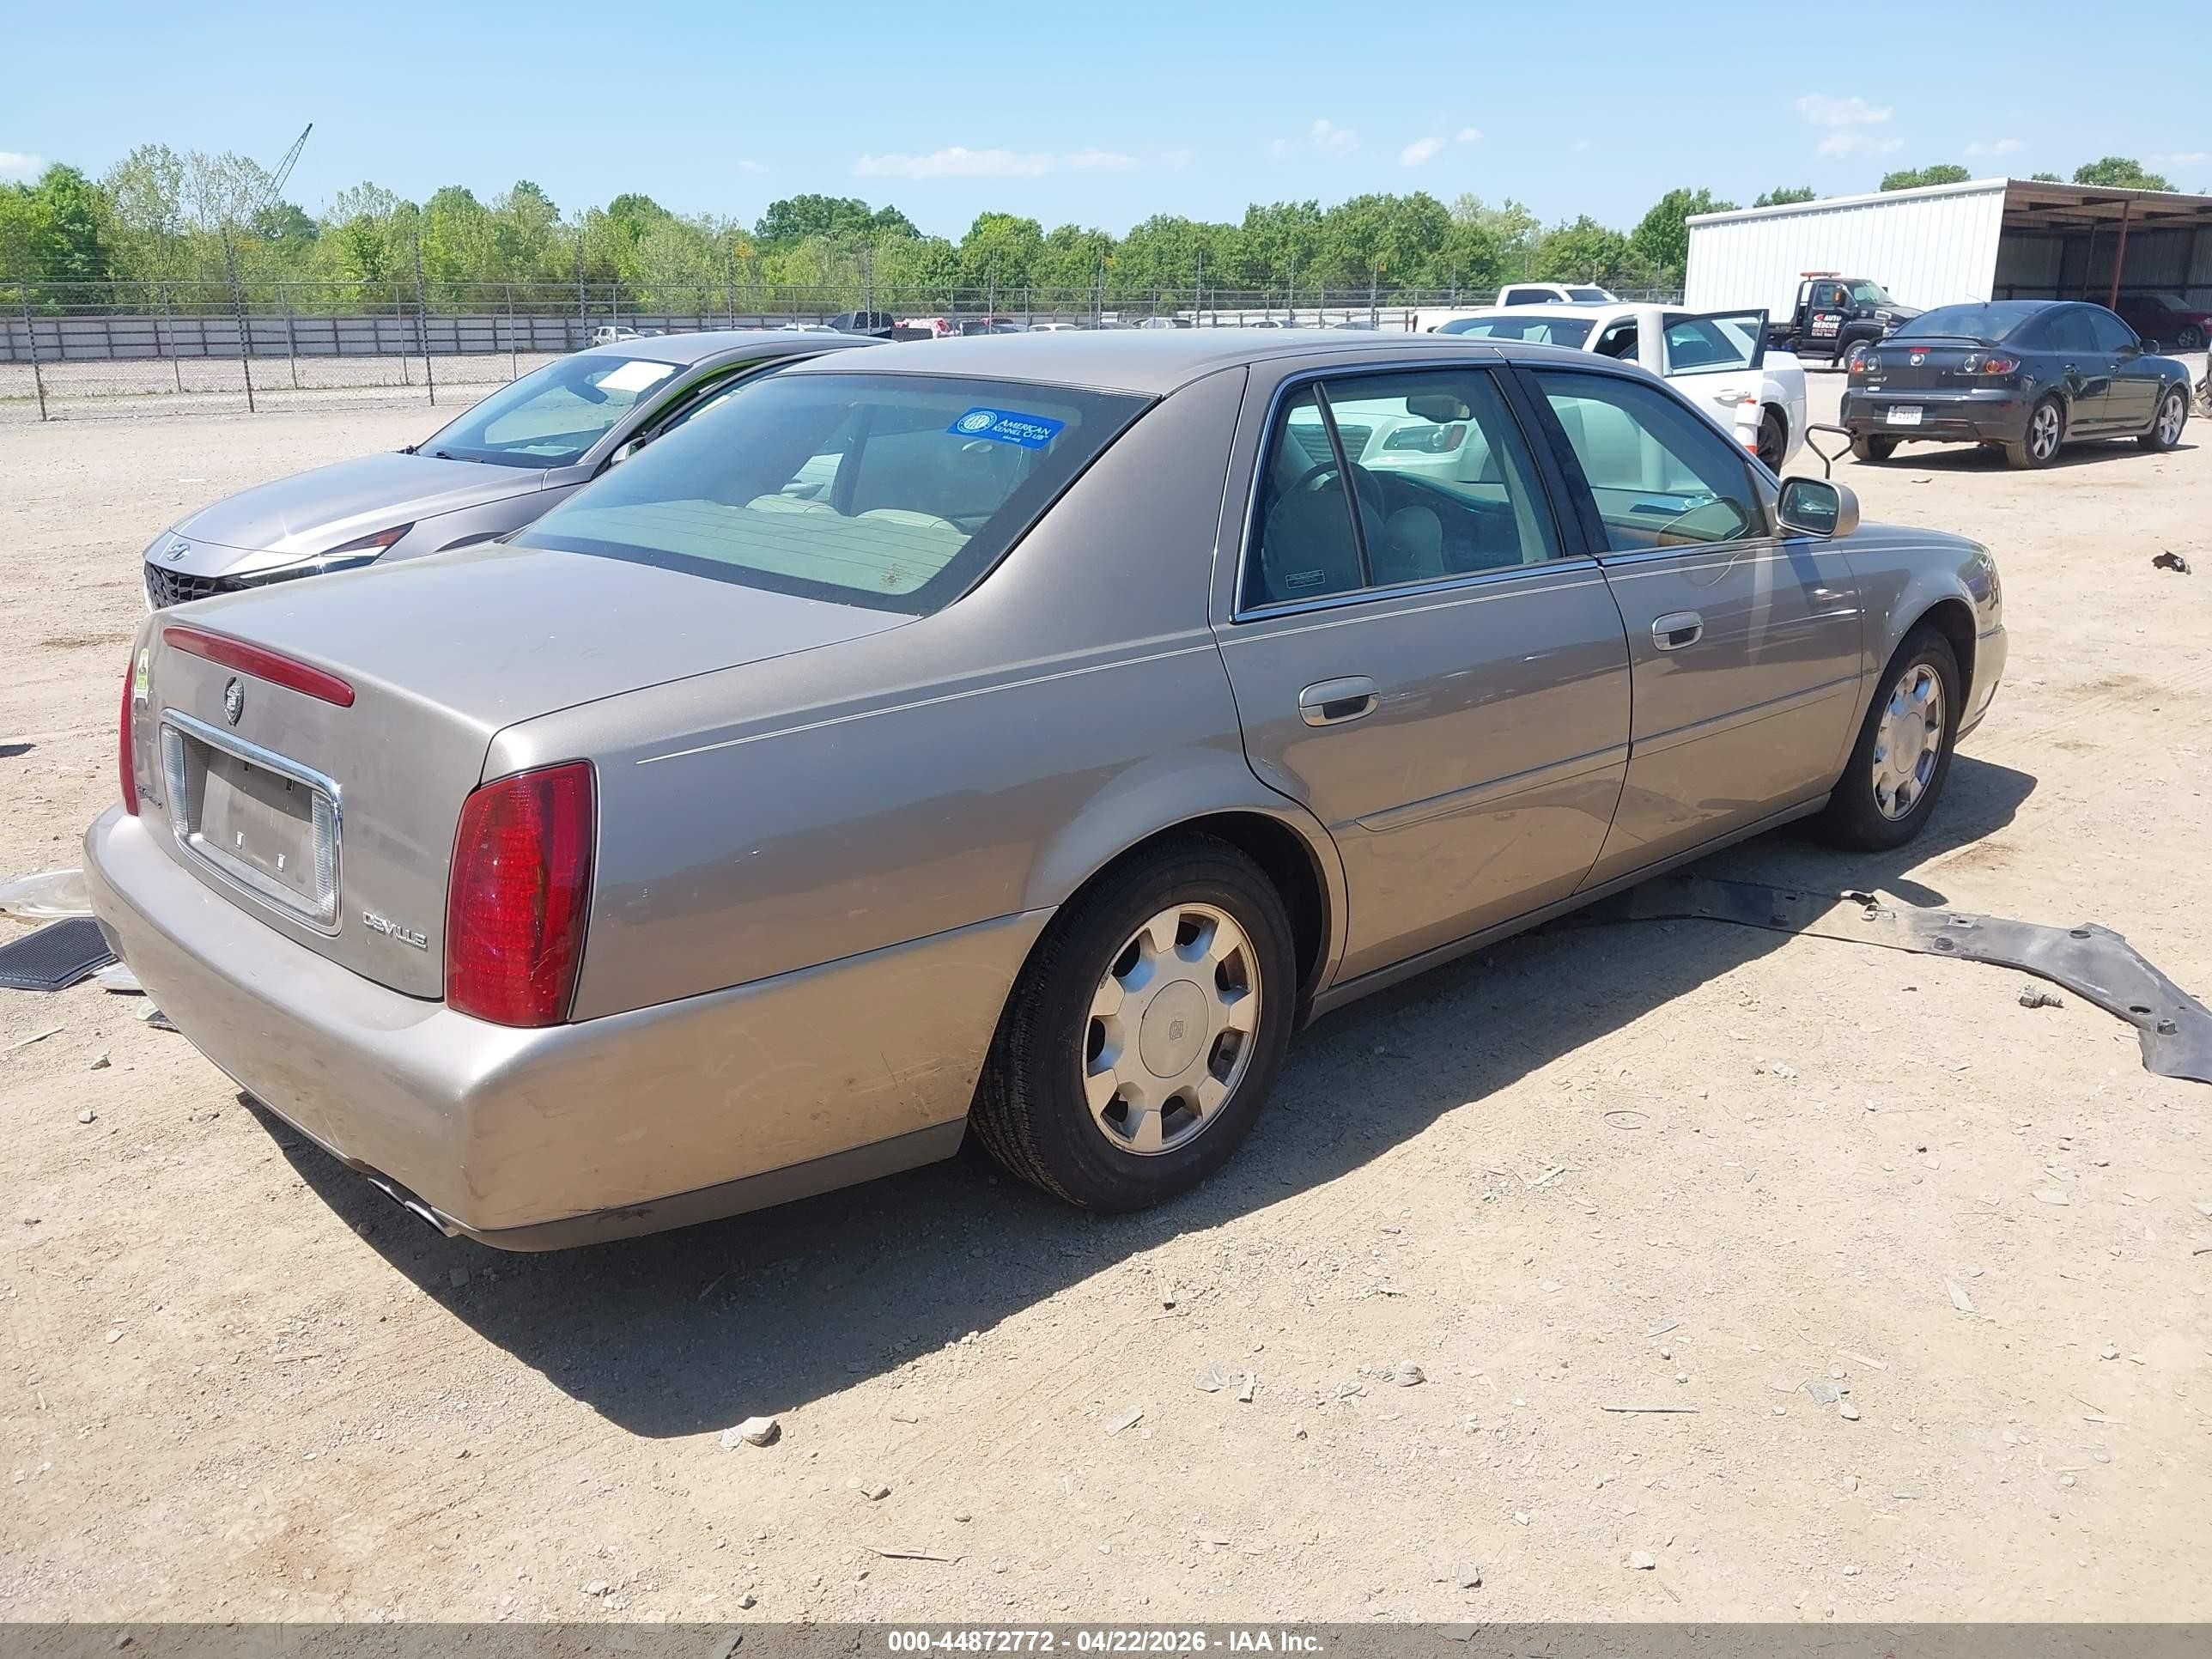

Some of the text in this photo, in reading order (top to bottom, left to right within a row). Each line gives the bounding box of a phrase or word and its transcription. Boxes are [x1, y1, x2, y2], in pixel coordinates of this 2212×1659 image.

[991, 424, 1021, 437] KENNEL
[997, 418, 1052, 436] AMERICAN
[362, 911, 427, 949] DEVILLE
